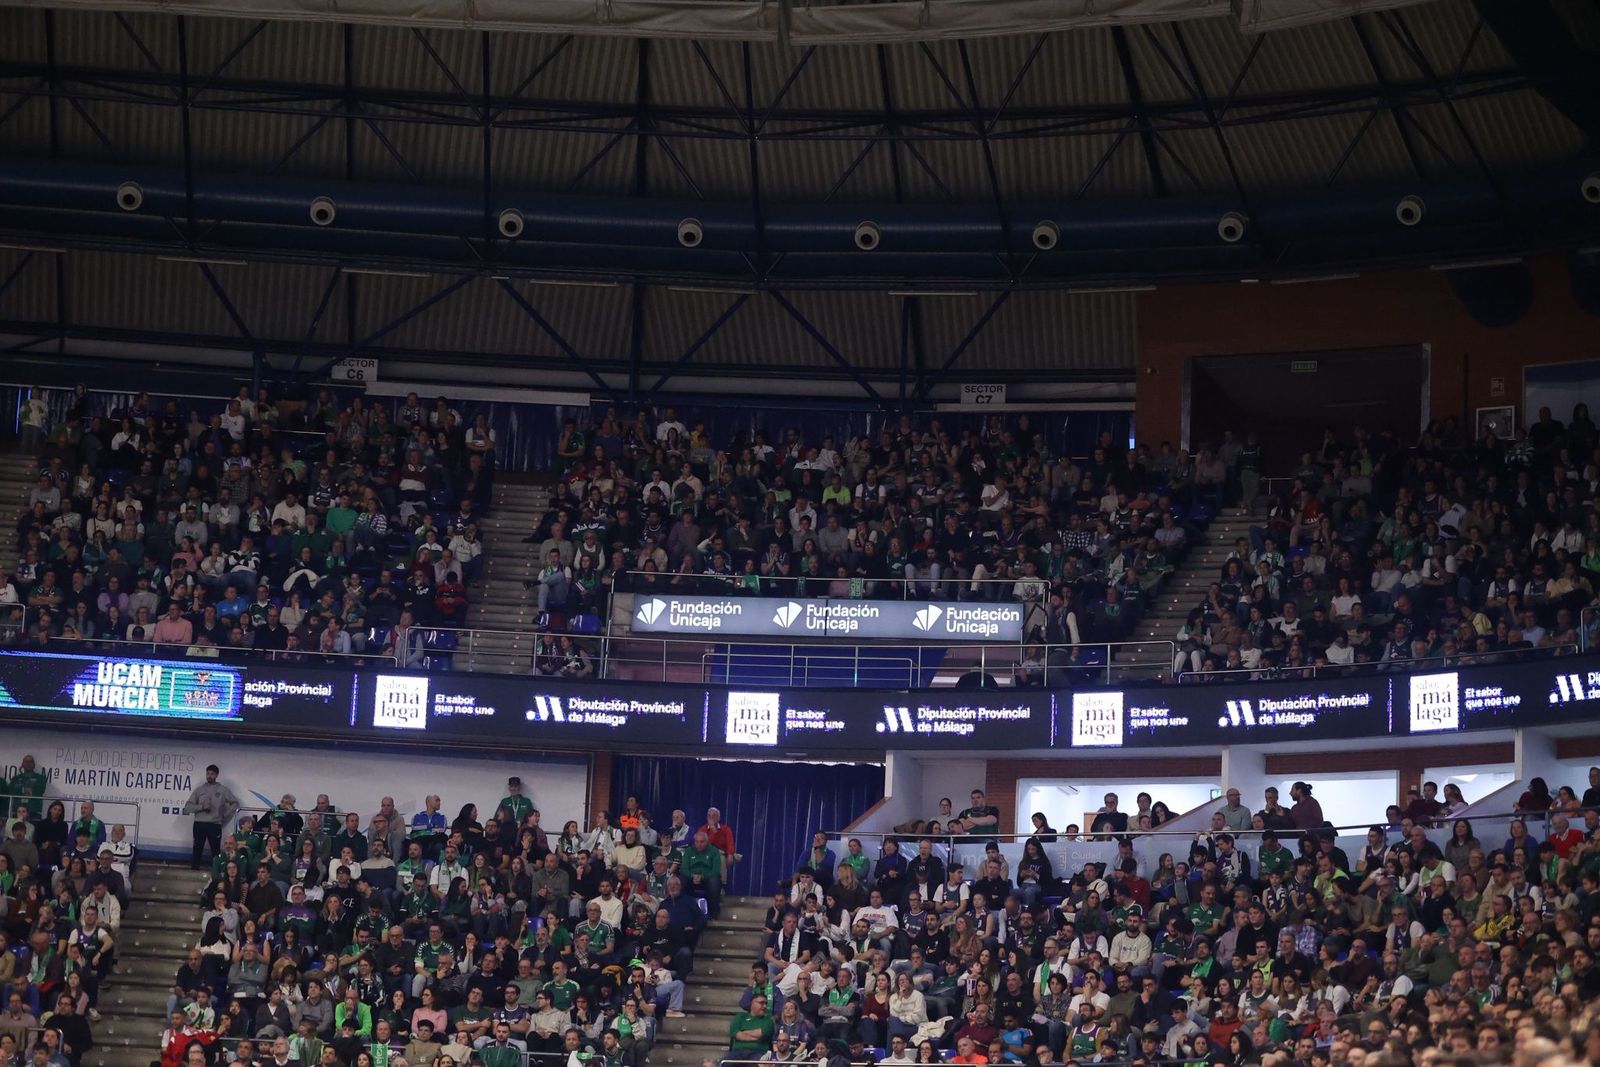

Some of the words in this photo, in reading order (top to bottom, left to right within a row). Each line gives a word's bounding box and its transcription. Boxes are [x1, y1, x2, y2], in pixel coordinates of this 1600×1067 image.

[347, 368, 364, 381] C6
[964, 384, 1004, 394] SECTOR
[975, 394, 993, 405] C7
[670, 600, 742, 616] Fundación
[806, 604, 880, 618] Fundación
[946, 606, 1020, 622] Fundación
[670, 613, 721, 631] Unicaja
[806, 616, 859, 634] Unicaja
[946, 619, 999, 637] Unicaja
[97, 661, 163, 688] UCAM
[73, 683, 160, 711] MURCIA
[277, 682, 333, 696] Provincial
[1465, 688, 1475, 698] El
[1475, 687, 1502, 698] sabor
[435, 693, 445, 703] El
[447, 695, 475, 705] sabor
[569, 697, 629, 713] Diputación
[630, 700, 684, 714] Provincial
[1258, 697, 1317, 713] Diputación
[1317, 694, 1370, 708] Provincial
[1465, 699, 1484, 710] que
[1484, 698, 1502, 707] nos
[1503, 695, 1521, 705] une
[381, 700, 420, 725] laga
[435, 704, 454, 715] que
[456, 705, 474, 714] nos
[476, 706, 495, 715] une
[786, 709, 796, 719] El
[798, 710, 826, 720] sabor
[917, 706, 976, 721] Diputación
[977, 706, 1030, 719] Provincial
[1130, 708, 1140, 718] El
[1141, 707, 1169, 717] sabor
[1416, 702, 1452, 726] laga
[569, 711, 583, 722] de
[585, 712, 626, 727] Málaga
[786, 719, 804, 730] que
[806, 720, 824, 729] nos
[825, 721, 845, 729] une
[917, 721, 932, 732] de
[933, 719, 975, 735] Málaga
[1130, 718, 1148, 729] que
[1150, 717, 1168, 727] nos
[1169, 717, 1188, 726] une
[1258, 713, 1273, 725] de
[1274, 711, 1315, 728] Málaga
[733, 717, 771, 740] laga
[1079, 719, 1116, 742] laga
[56, 748, 108, 768] PALACIO
[112, 751, 128, 769] DE
[131, 752, 195, 772] DEPORTES
[65, 768, 121, 788] MARTÍN
[125, 771, 193, 791] CARPENA
